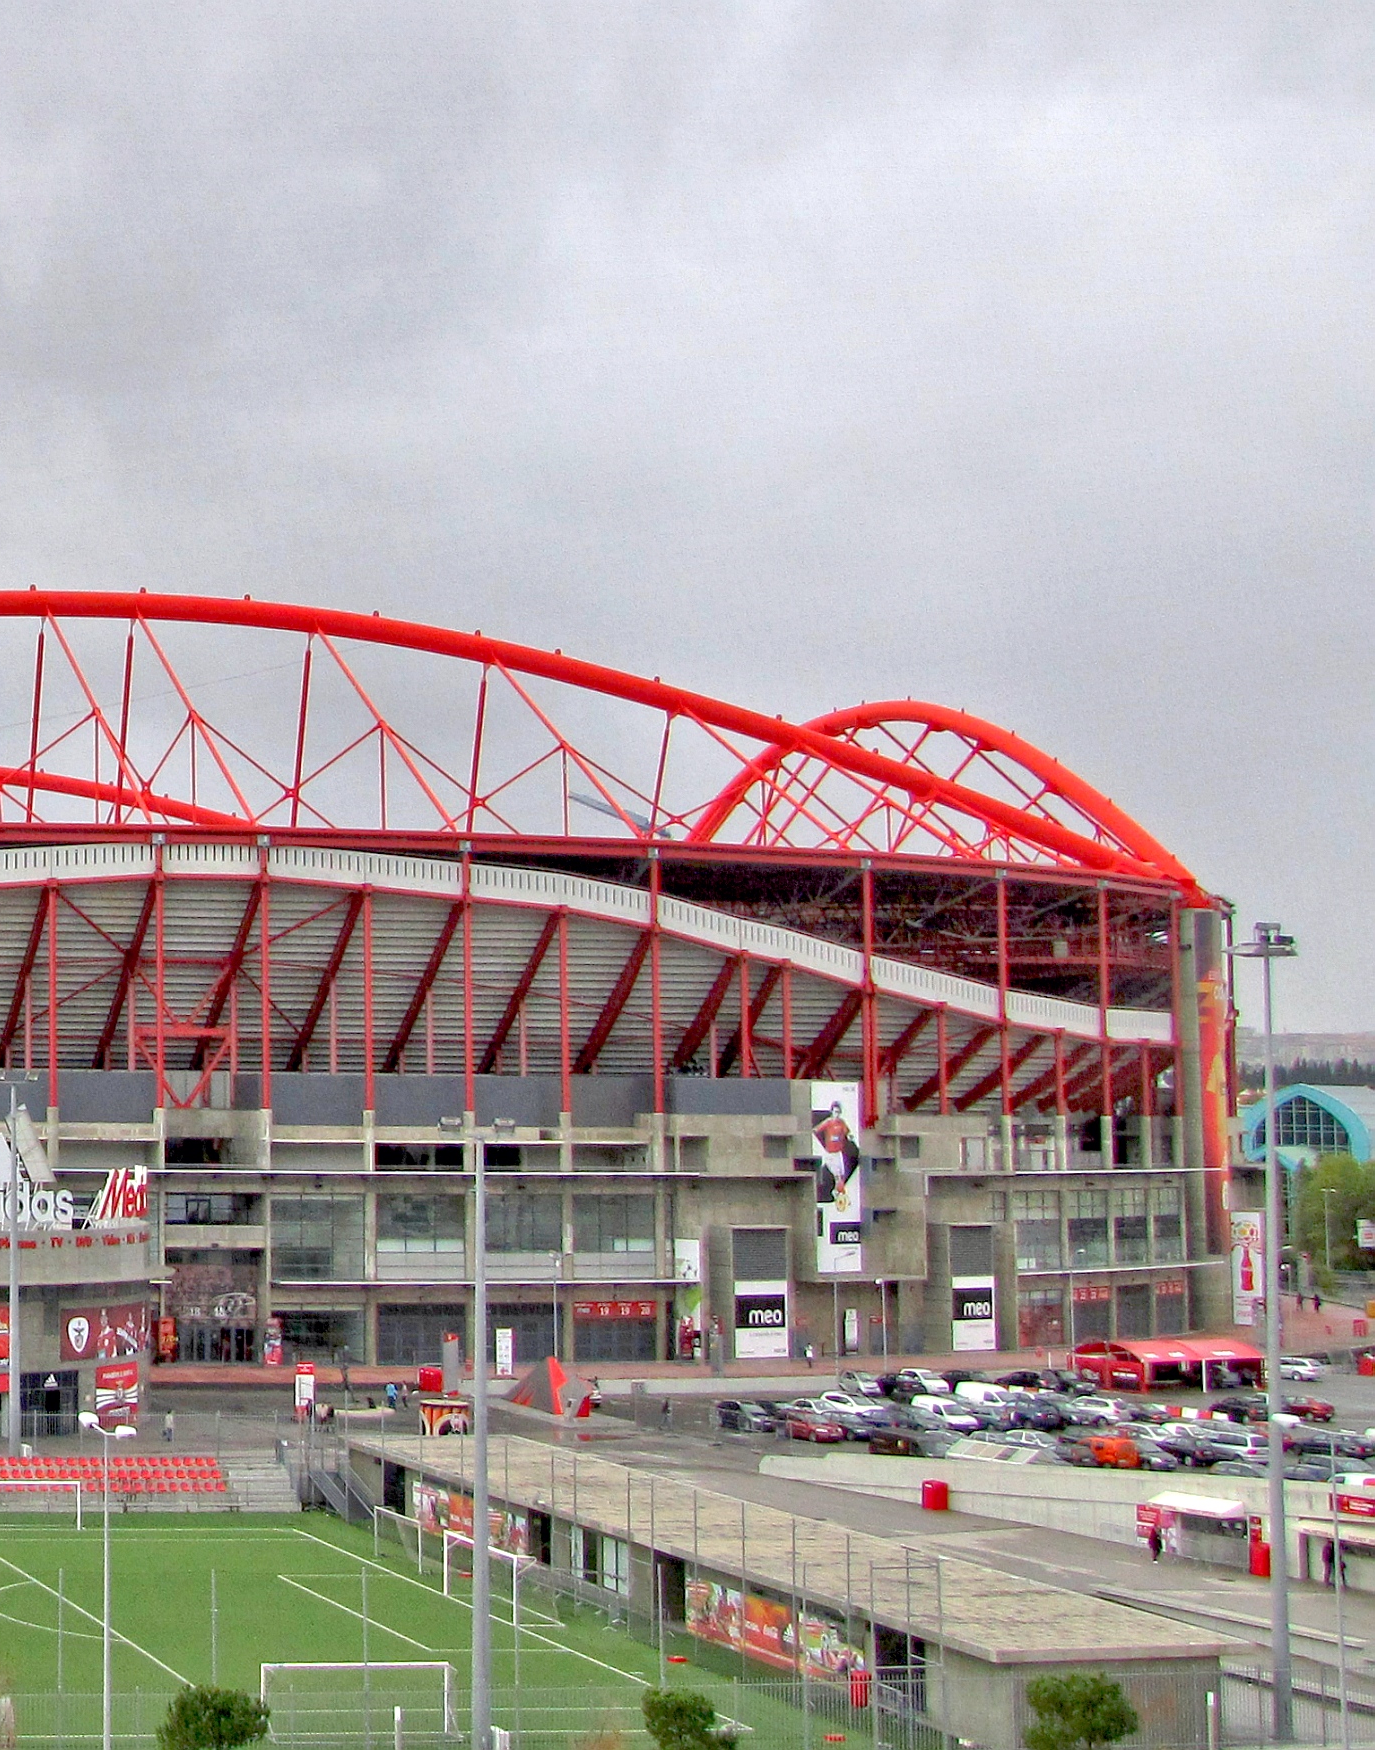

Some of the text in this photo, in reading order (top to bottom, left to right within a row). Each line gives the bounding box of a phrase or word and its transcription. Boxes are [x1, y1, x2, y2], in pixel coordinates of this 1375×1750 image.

[50, 1237, 63, 1248] TV
[837, 1230, 859, 1242] meo
[963, 1301, 991, 1316] meo
[748, 1308, 782, 1325] meo
